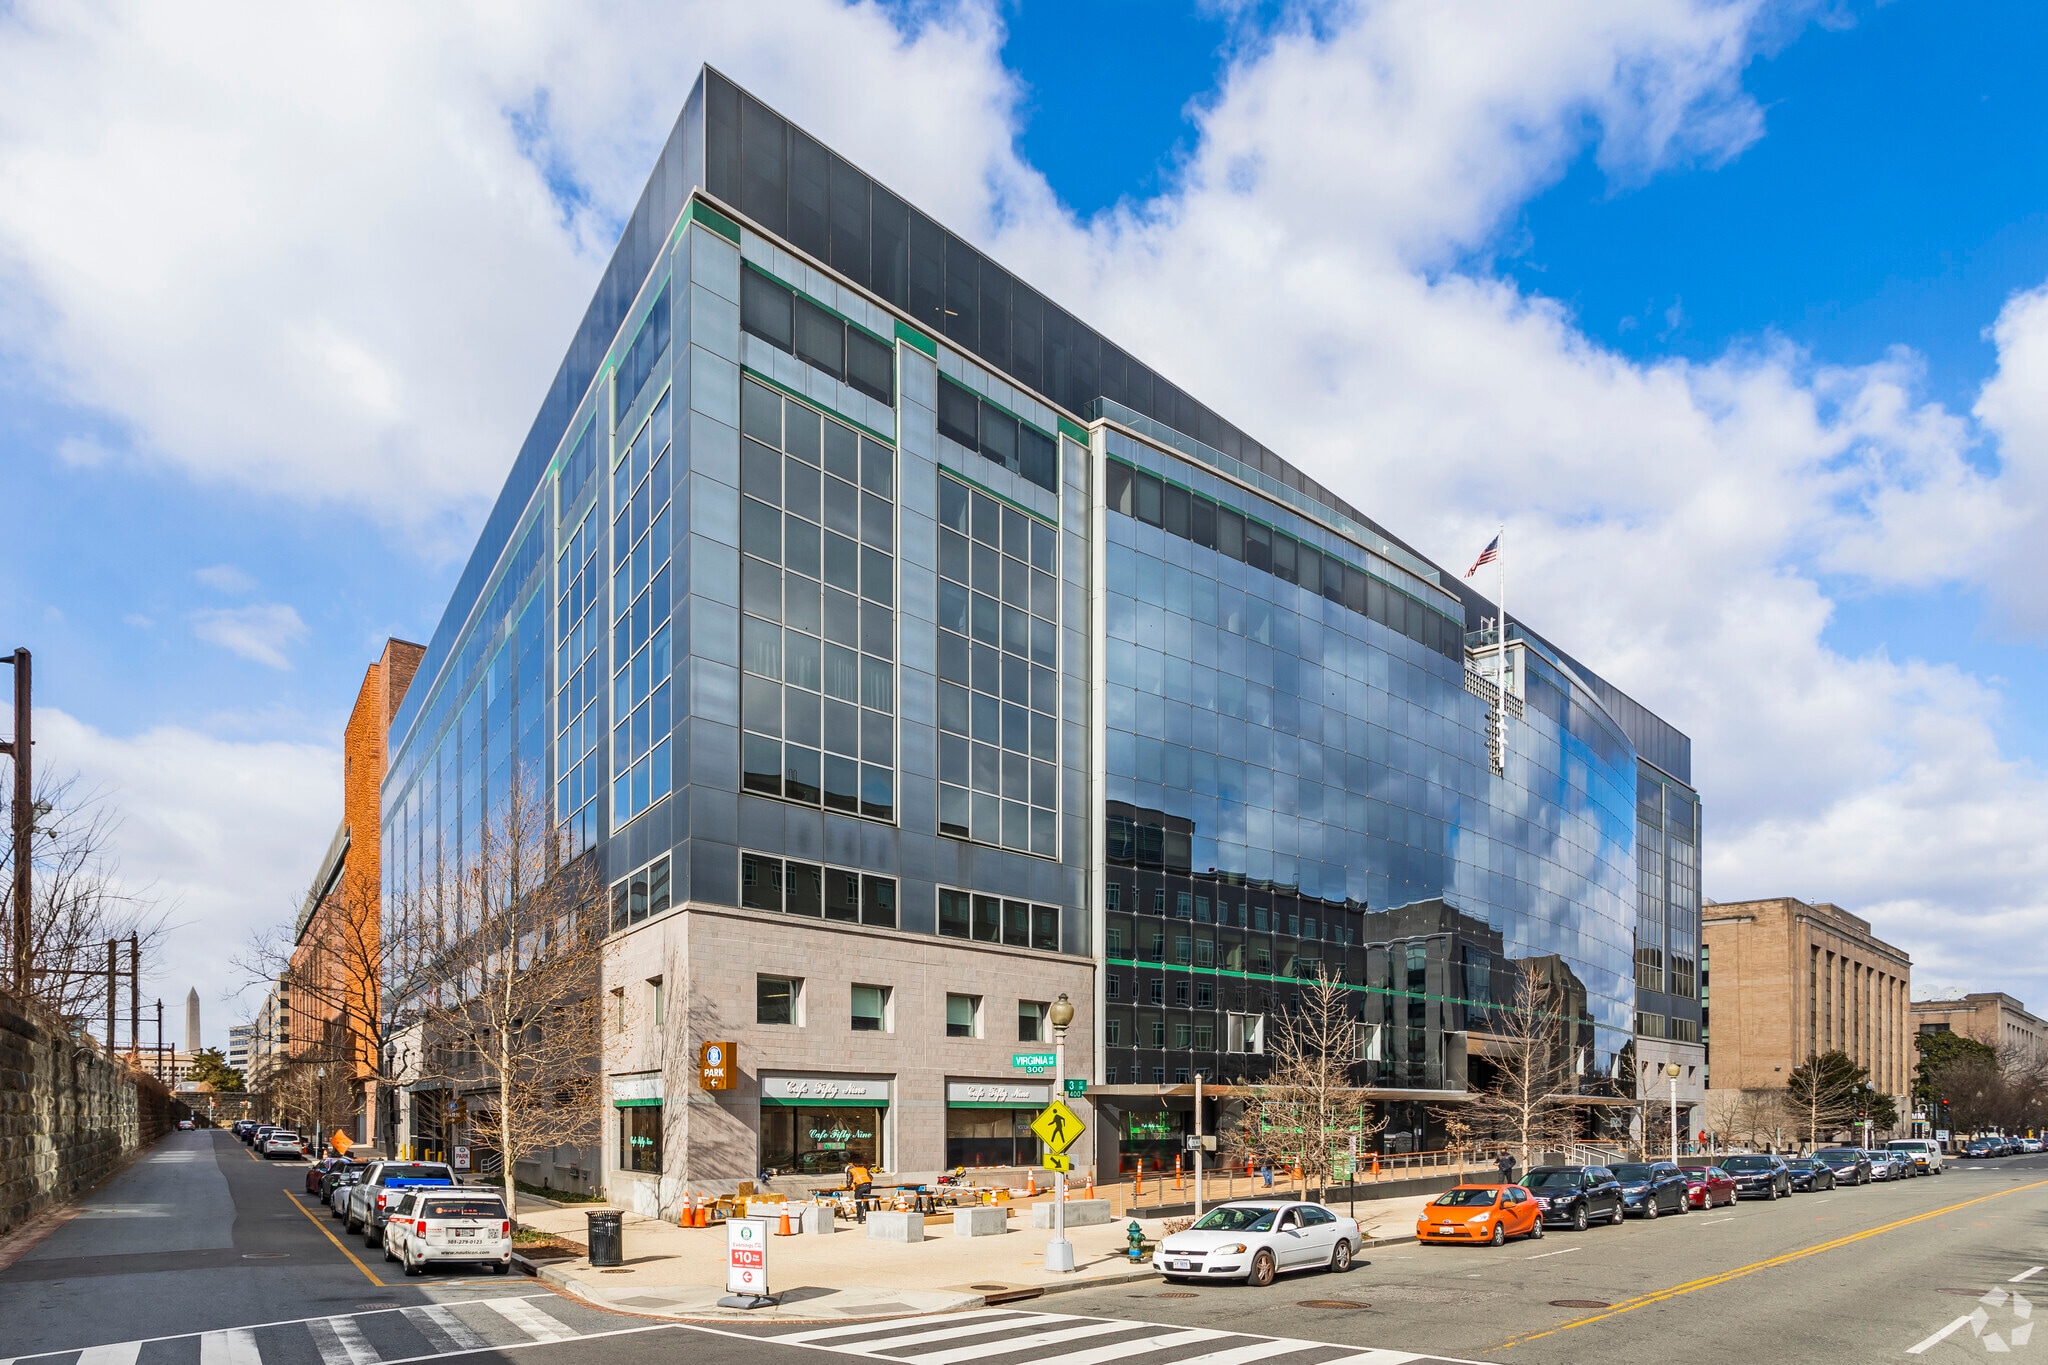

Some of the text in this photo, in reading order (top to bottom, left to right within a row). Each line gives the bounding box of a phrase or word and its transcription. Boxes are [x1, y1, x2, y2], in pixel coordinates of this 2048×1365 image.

[1015, 1056, 1048, 1065] VIRGINIA
[704, 1068, 725, 1077] PARK
[786, 1081, 866, 1099] Cafe Fifty Nine
[1069, 1080, 1075, 1090] 3
[967, 1086, 1031, 1102] Cafe Fifty Nine
[808, 1129, 873, 1142] Cafe Fifty Nine
[734, 1251, 752, 1264] $10
